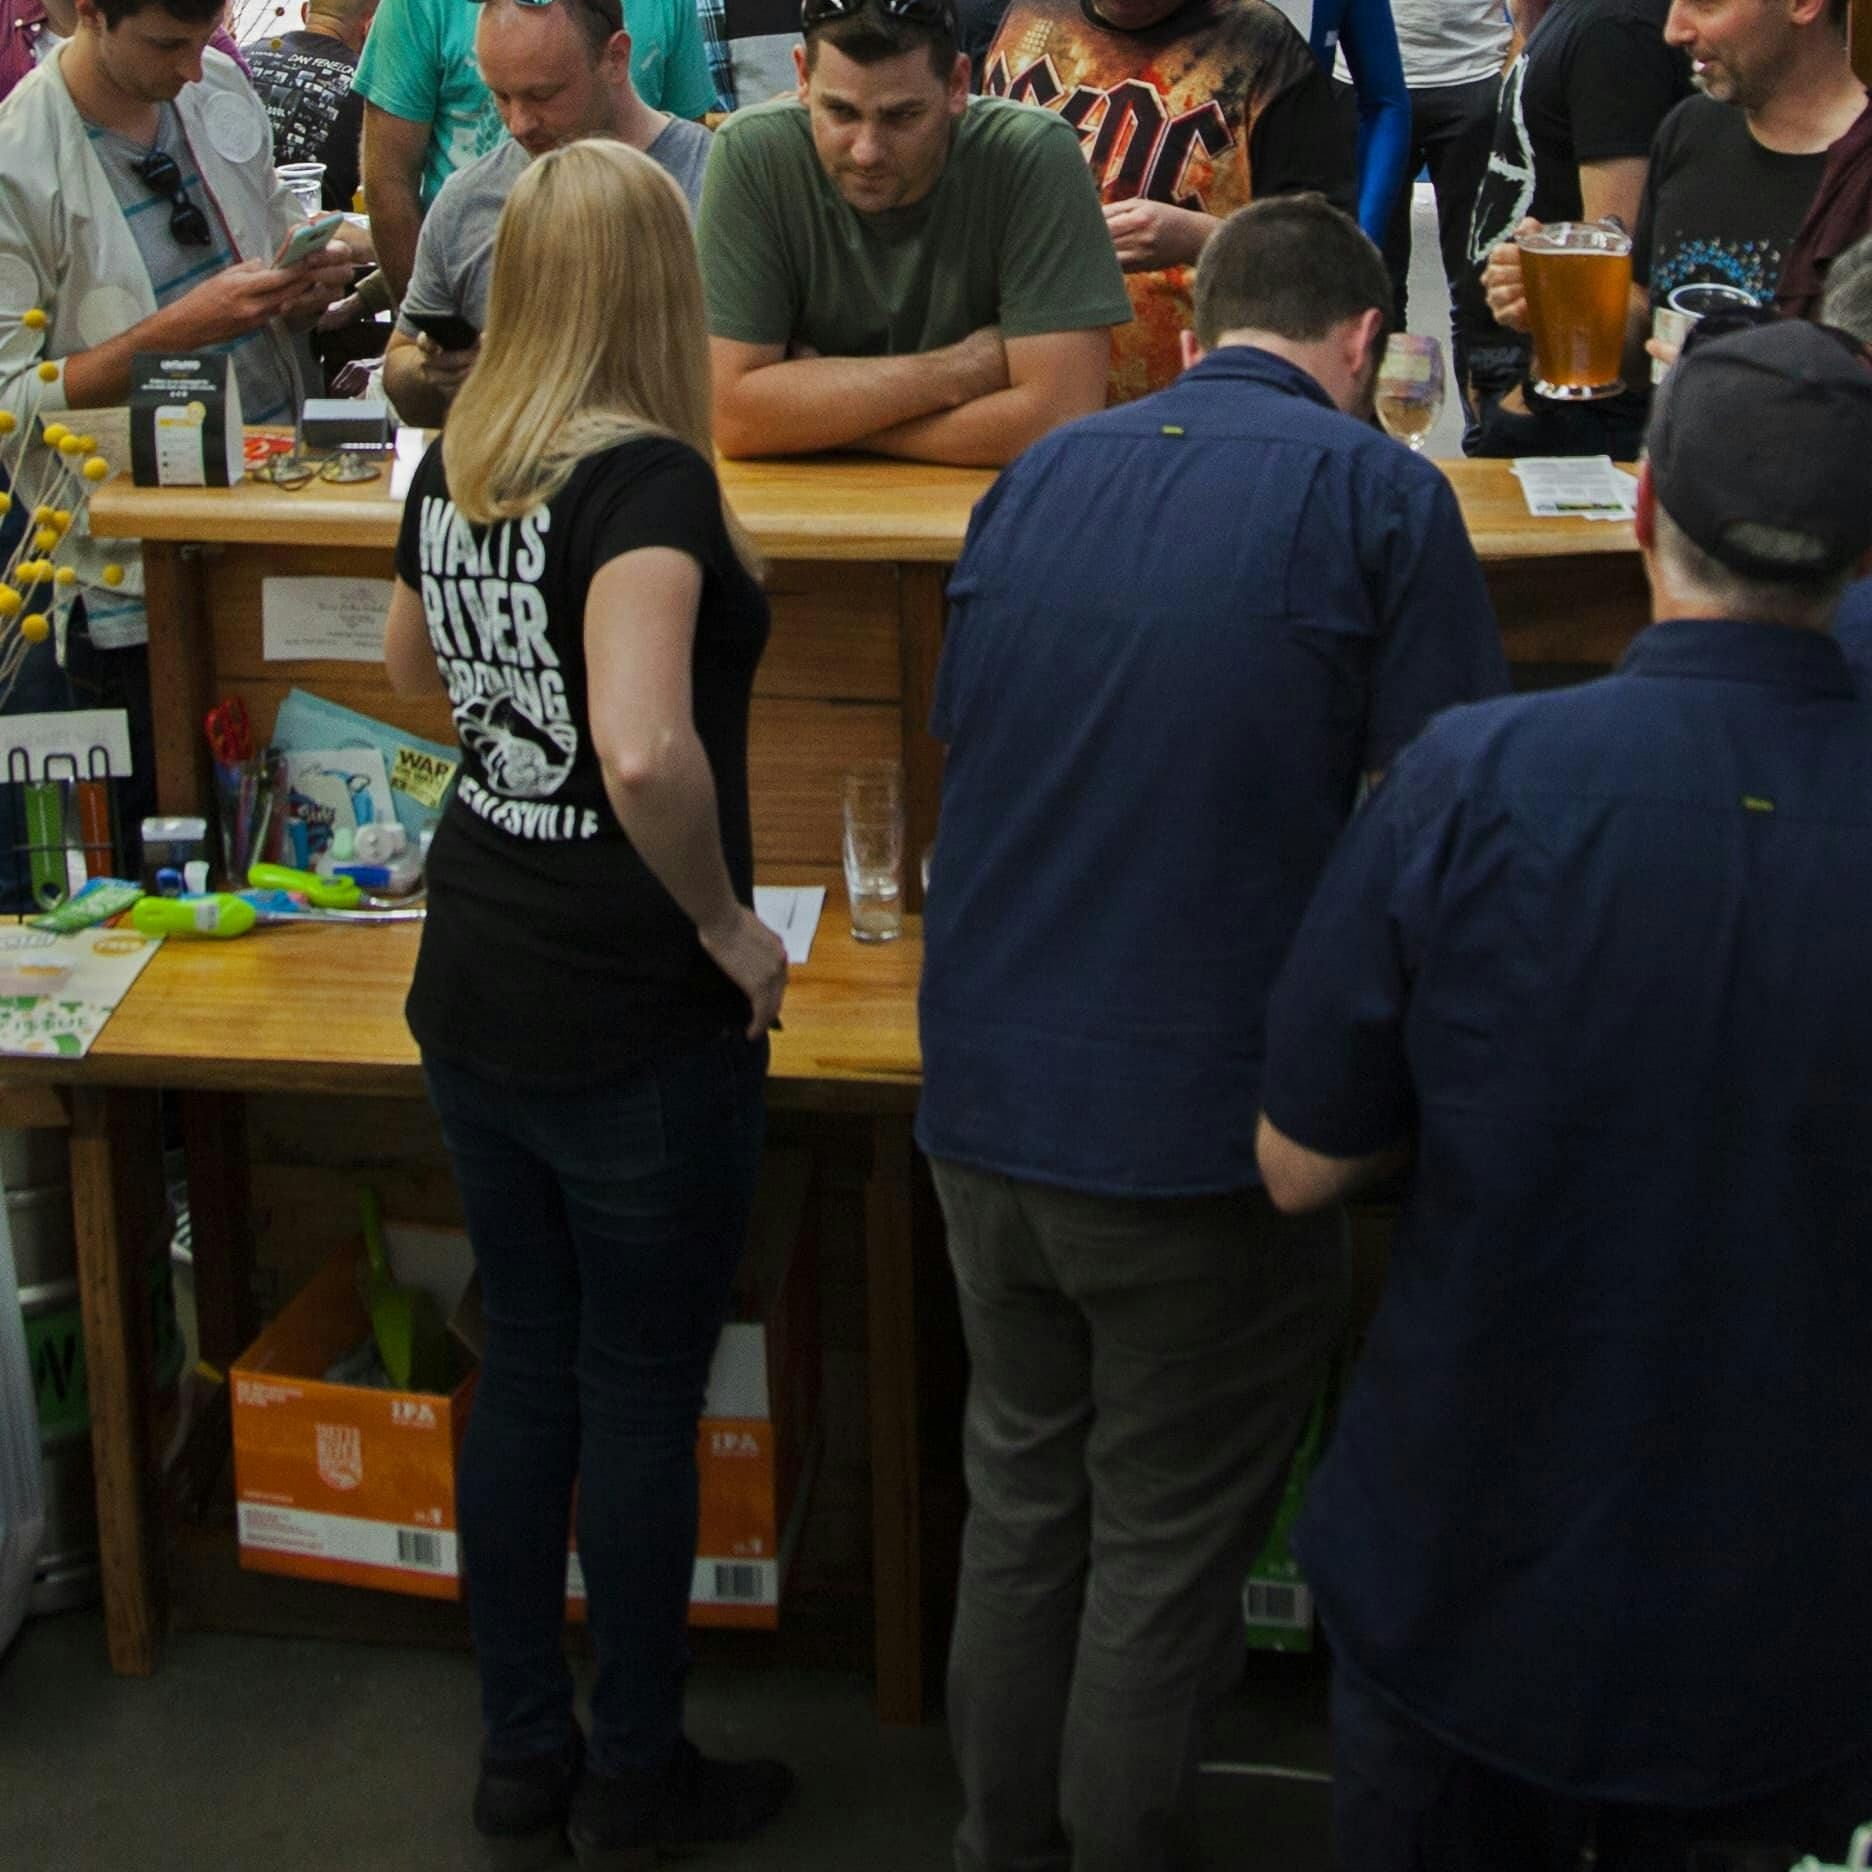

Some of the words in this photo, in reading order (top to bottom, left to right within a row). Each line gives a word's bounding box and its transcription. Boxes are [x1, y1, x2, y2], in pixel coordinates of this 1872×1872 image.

[421, 575, 560, 668] RIVER
[390, 1400, 436, 1426] IPA
[711, 1431, 759, 1453] IPA
